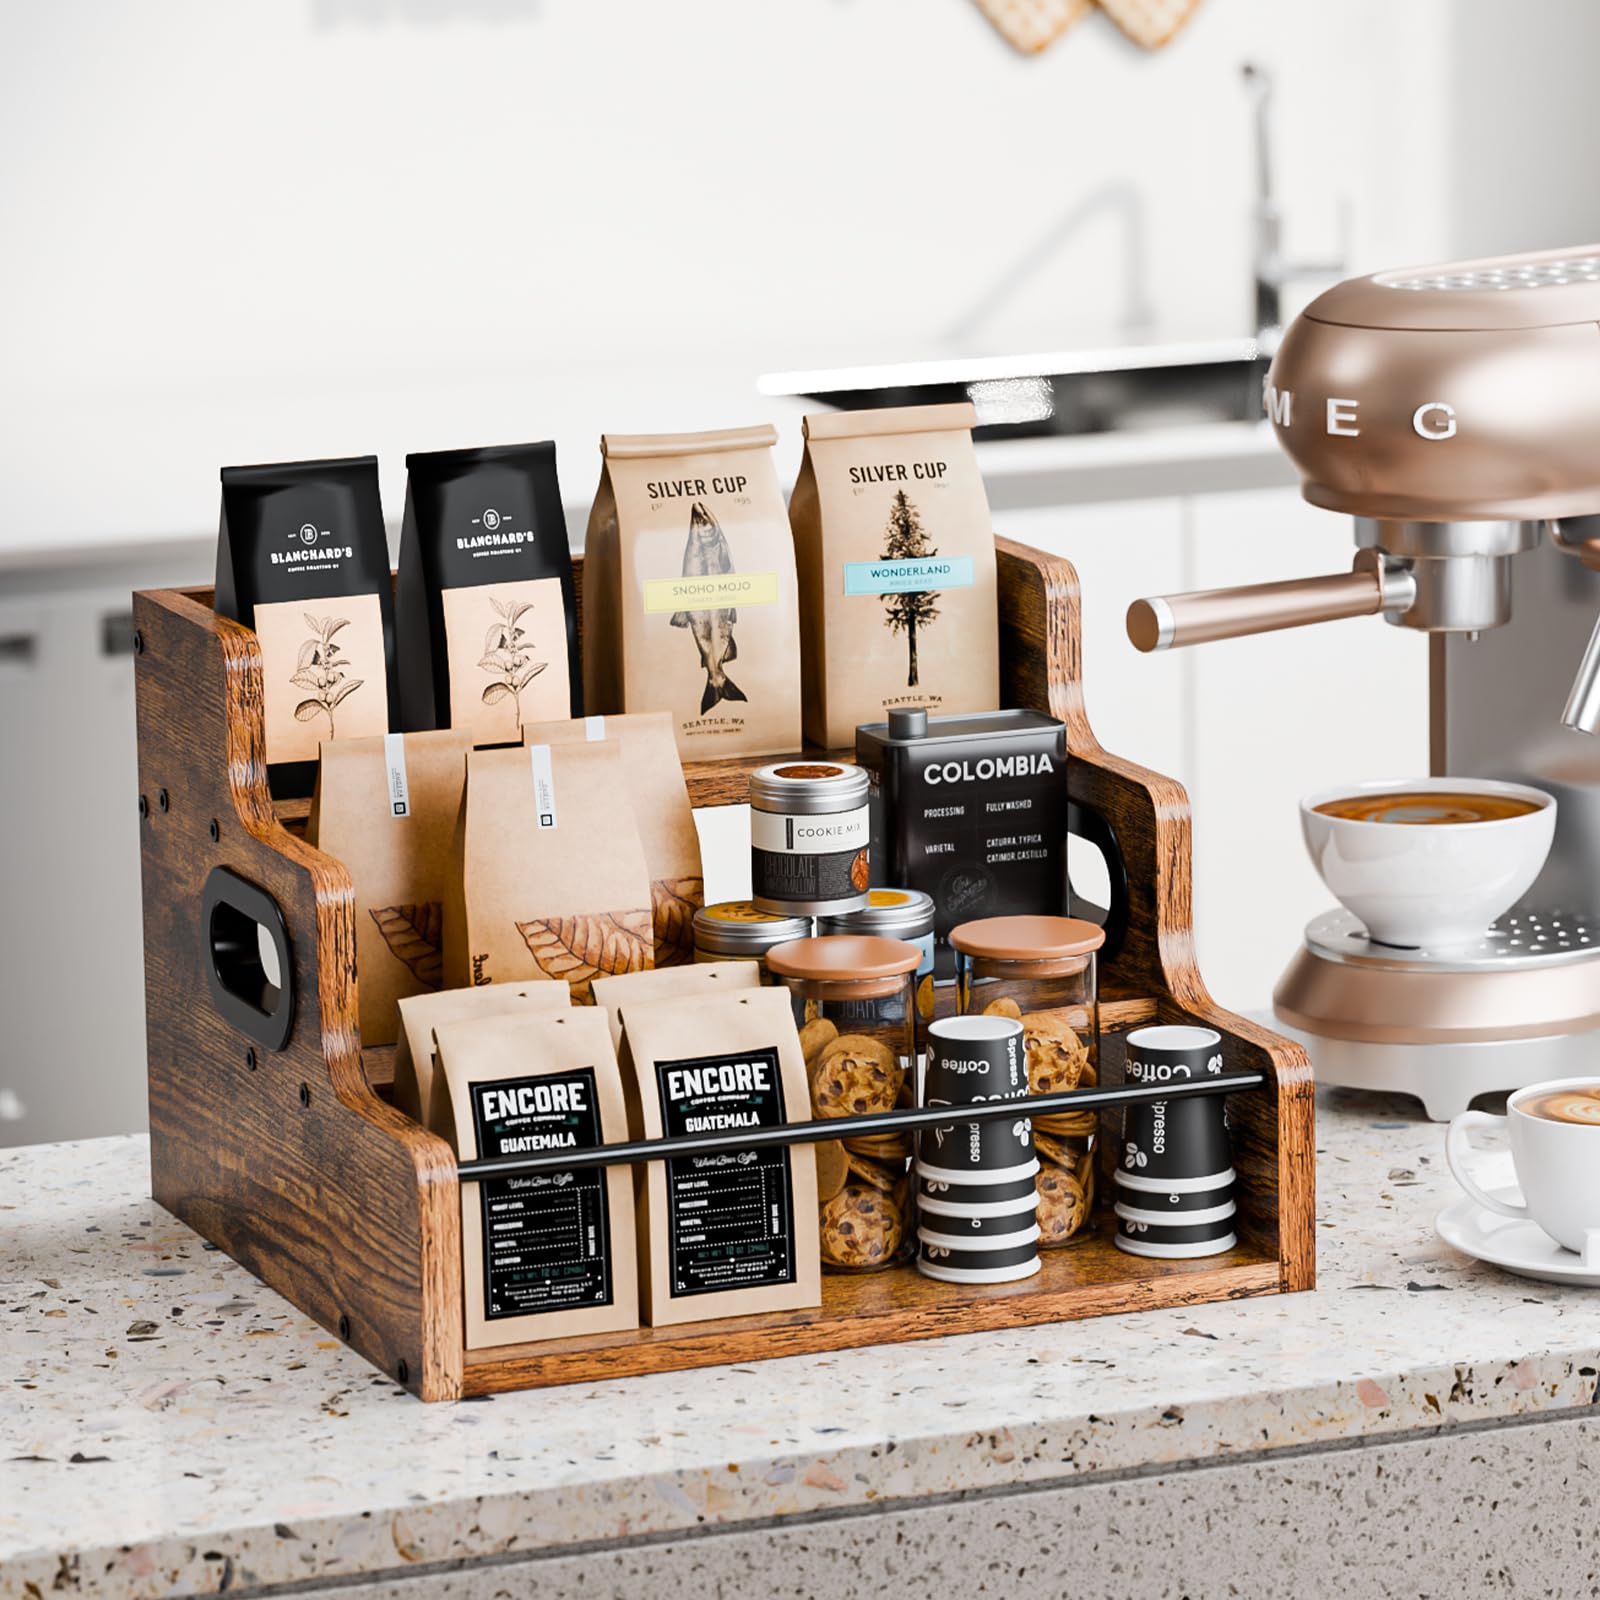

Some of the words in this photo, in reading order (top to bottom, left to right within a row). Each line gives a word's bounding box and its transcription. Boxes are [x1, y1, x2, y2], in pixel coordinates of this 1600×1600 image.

[1263, 374, 1457, 440] MEG
[849, 464, 908, 484] SILVER
[913, 462, 948, 481] CUP
[647, 479, 707, 499] SILVER
[713, 476, 748, 494] CUP
[456, 530, 534, 549] BLANCHARD'S
[270, 546, 353, 564] BLANCHARD'S
[870, 565, 951, 578] WONDERLAND
[672, 584, 715, 596] SNOHO
[718, 581, 751, 592] MOJO
[731, 717, 745, 725] WA
[923, 753, 1054, 785] COLOMBIA
[924, 806, 965, 818] PROCESSING
[985, 802, 1005, 812] FULLY
[1006, 799, 1032, 811] WASHED
[797, 826, 843, 837] COOKIE
[1019, 834, 1042, 845] TYPICA
[925, 843, 955, 855] VARIETAL
[1017, 849, 1048, 860] CASTILLO
[941, 1059, 990, 1075] Coffee
[667, 1062, 771, 1101] ENCORE
[482, 1082, 587, 1121] ENCORE
[686, 1111, 760, 1132] GUATEMALA
[500, 1132, 577, 1154] GUATEMALA
